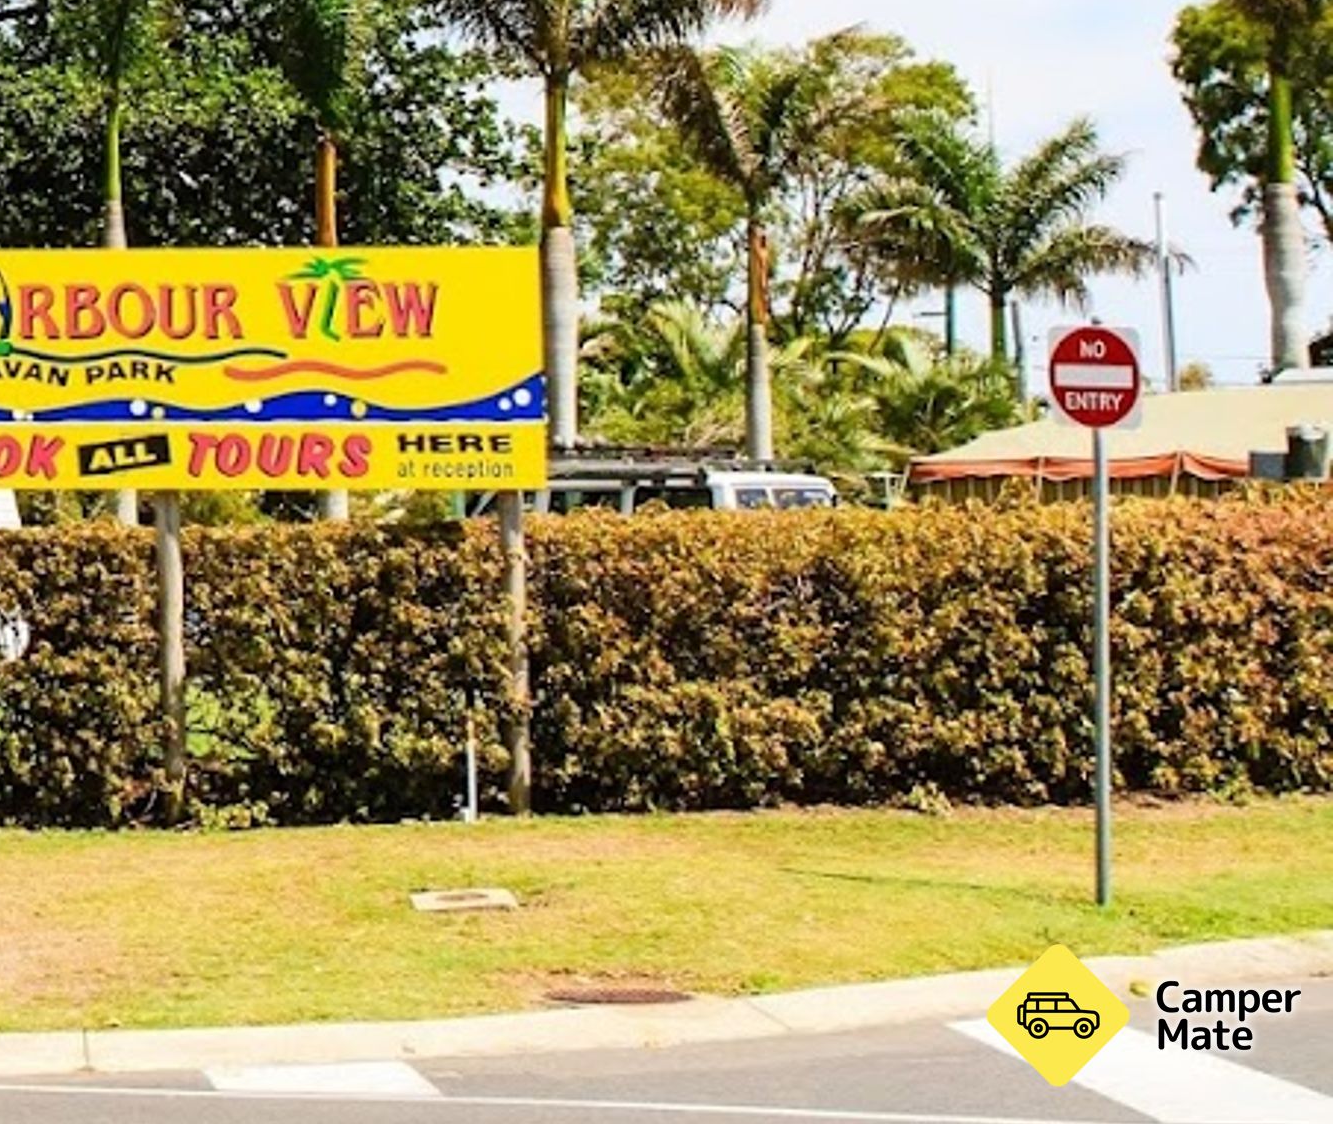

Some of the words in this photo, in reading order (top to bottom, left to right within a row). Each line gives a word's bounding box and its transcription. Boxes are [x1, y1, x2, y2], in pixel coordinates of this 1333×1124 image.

[275, 258, 439, 341] VIEW
[1079, 340, 1107, 358] NO
[85, 360, 178, 384] PARK
[1065, 392, 1124, 410] ENTRY
[89, 443, 158, 471] ALL
[187, 433, 372, 479] TOURS
[397, 434, 513, 453] HERE
[397, 462, 416, 477] at
[423, 460, 514, 479] reception
